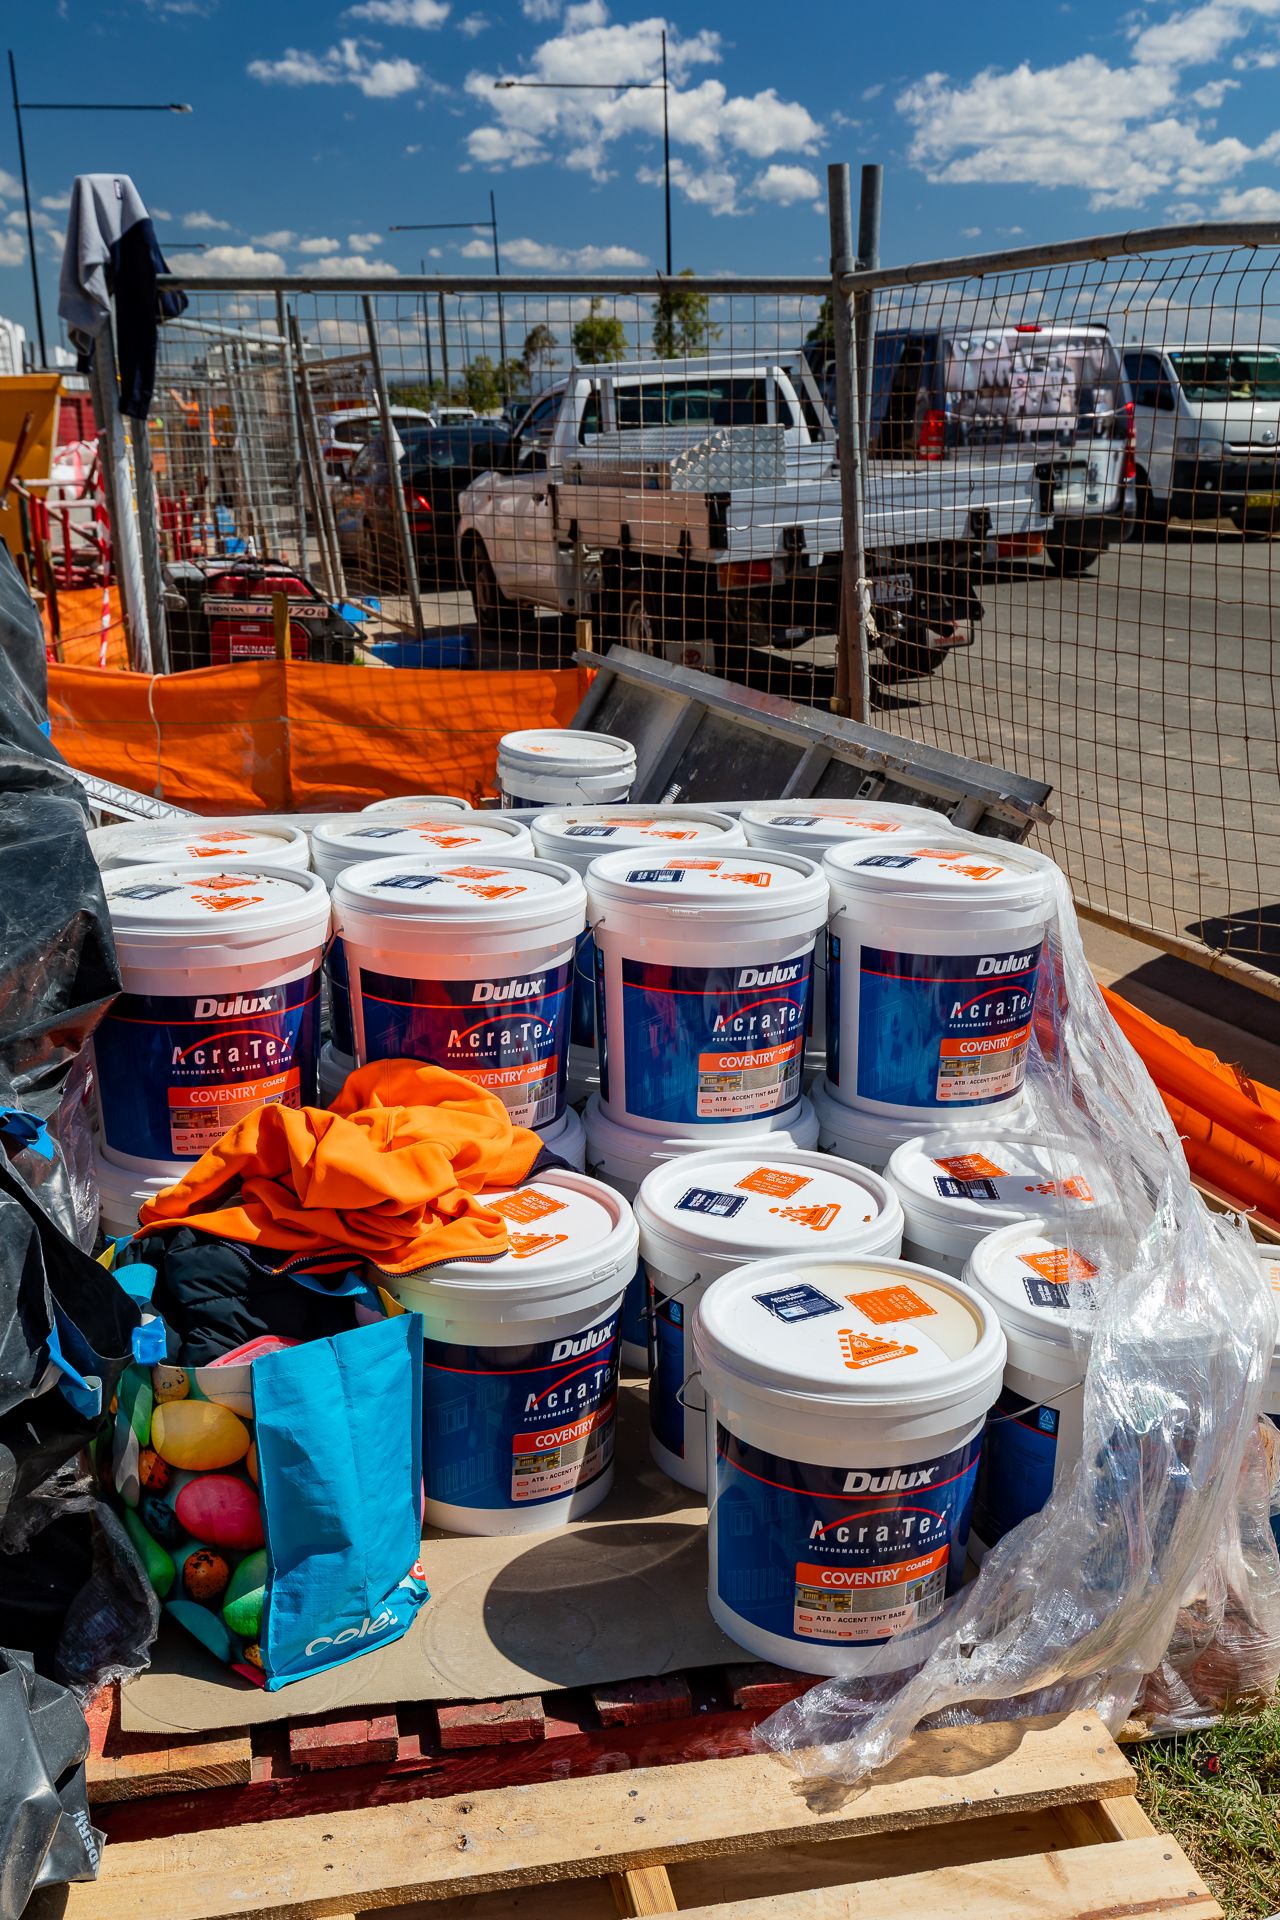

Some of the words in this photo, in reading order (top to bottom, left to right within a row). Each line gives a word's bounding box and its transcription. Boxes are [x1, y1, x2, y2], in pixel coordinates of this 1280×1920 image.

[976, 955, 1031, 976] Dulux
[738, 965, 798, 988] Dulux
[472, 979, 543, 1002] Dulux
[194, 995, 272, 1018] Dulux
[448, 1050, 497, 1058] PERFORMANCE
[503, 1046, 529, 1055] COATING
[959, 1036, 1010, 1053] COVENTRY
[232, 1064, 261, 1072] COATING
[266, 1056, 292, 1067] SYSTEMS
[719, 1052, 774, 1069] COVENTRY
[190, 1085, 257, 1104] COVENTRY
[262, 1076, 286, 1089] COARSE
[731, 1093, 753, 1101] ACCENT
[755, 1090, 767, 1098] TINT
[767, 1088, 779, 1096] BASE
[897, 1293, 909, 1301] DO
[551, 1321, 613, 1362] Dulux
[858, 1350, 908, 1367] WARNING
[524, 1406, 574, 1422] PERFORMANCE
[535, 1417, 595, 1448] COVENTRY
[531, 1476, 545, 1484] ATB
[549, 1467, 573, 1480] ACCENT
[843, 1466, 934, 1493] Dulux
[809, 1544, 870, 1554] PERFORMANCE
[878, 1542, 911, 1553] COATING
[918, 1530, 947, 1546] SYSTEMS
[821, 1568, 900, 1585] COVENTRY
[905, 1557, 934, 1572] COARSE
[889, 1610, 906, 1618] BASE
